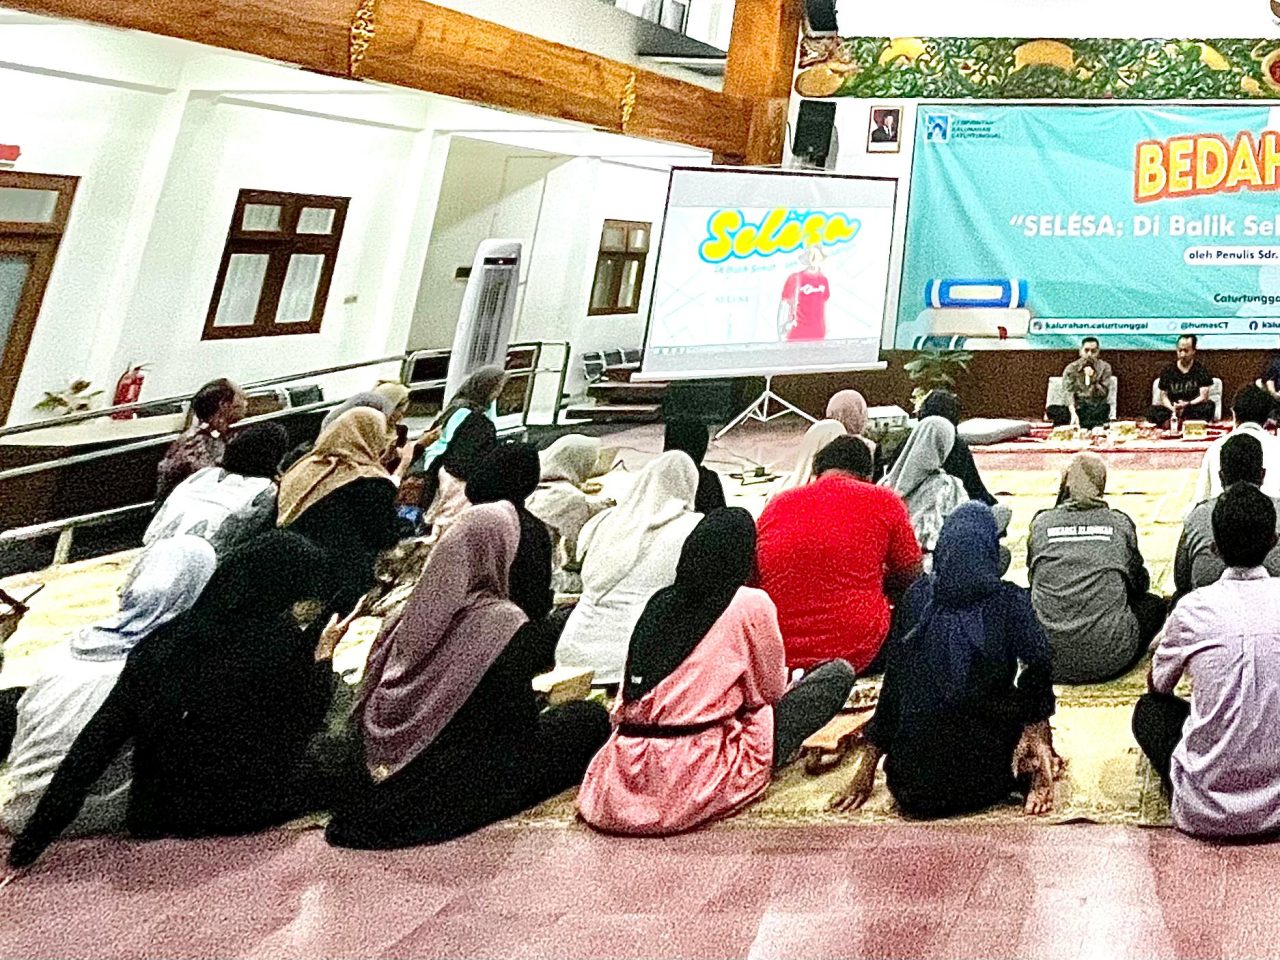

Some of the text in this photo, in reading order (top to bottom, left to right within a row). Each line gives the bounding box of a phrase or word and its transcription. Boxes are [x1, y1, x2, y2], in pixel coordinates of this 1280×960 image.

[1133, 214, 1160, 237] Di
[1169, 213, 1235, 237] Balik
[1189, 250, 1213, 260] oleh
[1216, 250, 1255, 260] Penulis
[1258, 250, 1279, 260] Sdr.
[1180, 321, 1229, 330] @humasCT
